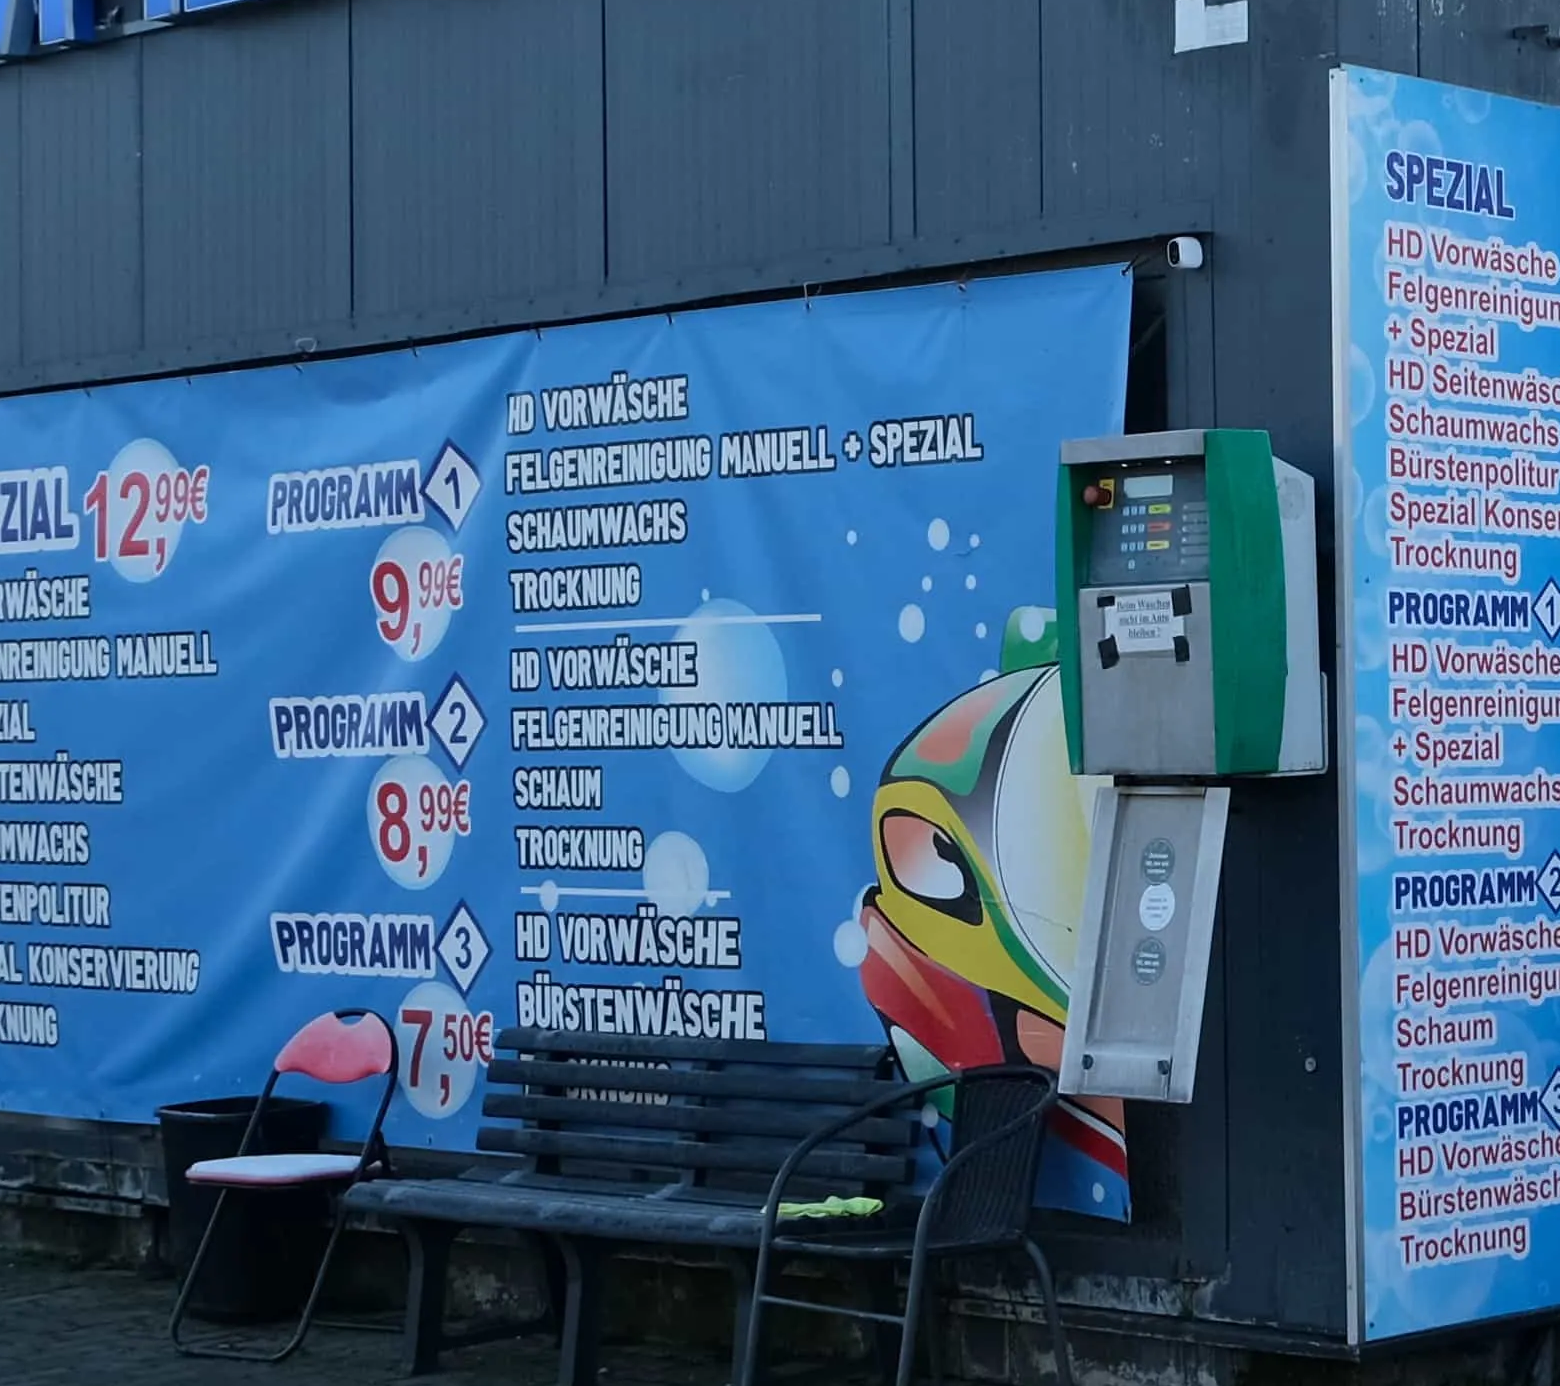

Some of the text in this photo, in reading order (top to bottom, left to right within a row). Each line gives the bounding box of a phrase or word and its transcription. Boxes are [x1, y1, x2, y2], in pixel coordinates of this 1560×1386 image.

[1386, 152, 1514, 217] SPEZIAL
[1388, 228, 1556, 278] HD Vorwäsche
[1388, 321, 1495, 357] + Spezial
[1389, 361, 1424, 391] HD
[508, 375, 686, 433] HD VORWÄSCHE
[1390, 406, 1558, 447] Schaumwachs
[506, 417, 981, 492] FELGENREINIGUNG MANUELL + SPEZIAL
[1390, 449, 1558, 490] Bürstenpolitur
[272, 468, 460, 525] PROGRAMM 1
[1391, 493, 1476, 531] Spezial
[508, 502, 686, 551] SCHAUMWACHS
[1392, 538, 1516, 577] Trocknung
[511, 567, 639, 610] TROCKNUNG
[1389, 592, 1554, 627] PROGRAMM 1
[116, 634, 216, 675] MANUELL
[511, 638, 696, 689] HD VORWÄSCHE
[1393, 645, 1426, 673] HD
[274, 701, 466, 749] PROGRAMM 2
[512, 705, 842, 748] FELGENREINIGUNG MANUELL
[1393, 734, 1499, 767] + Spezial
[514, 769, 601, 808] SCHAUM
[516, 830, 642, 868] TROCKNUNG
[1394, 820, 1521, 852] Trocknung
[1395, 872, 1534, 910] PROGRAMM
[276, 921, 471, 971] PROGRAMM 3
[516, 909, 739, 965] HD VORWÄSCHE
[1396, 930, 1430, 959] HD
[28, 945, 199, 992] KONSERVIERUNG
[519, 974, 765, 1039] BÜRSTENWÄSCHE
[1397, 1019, 1493, 1048] Schaum
[1398, 1057, 1523, 1093] Trocknung
[1399, 1095, 1538, 1138] PROGRAMM
[1400, 1146, 1433, 1178] HD
[1401, 1221, 1527, 1265] Trocknung
